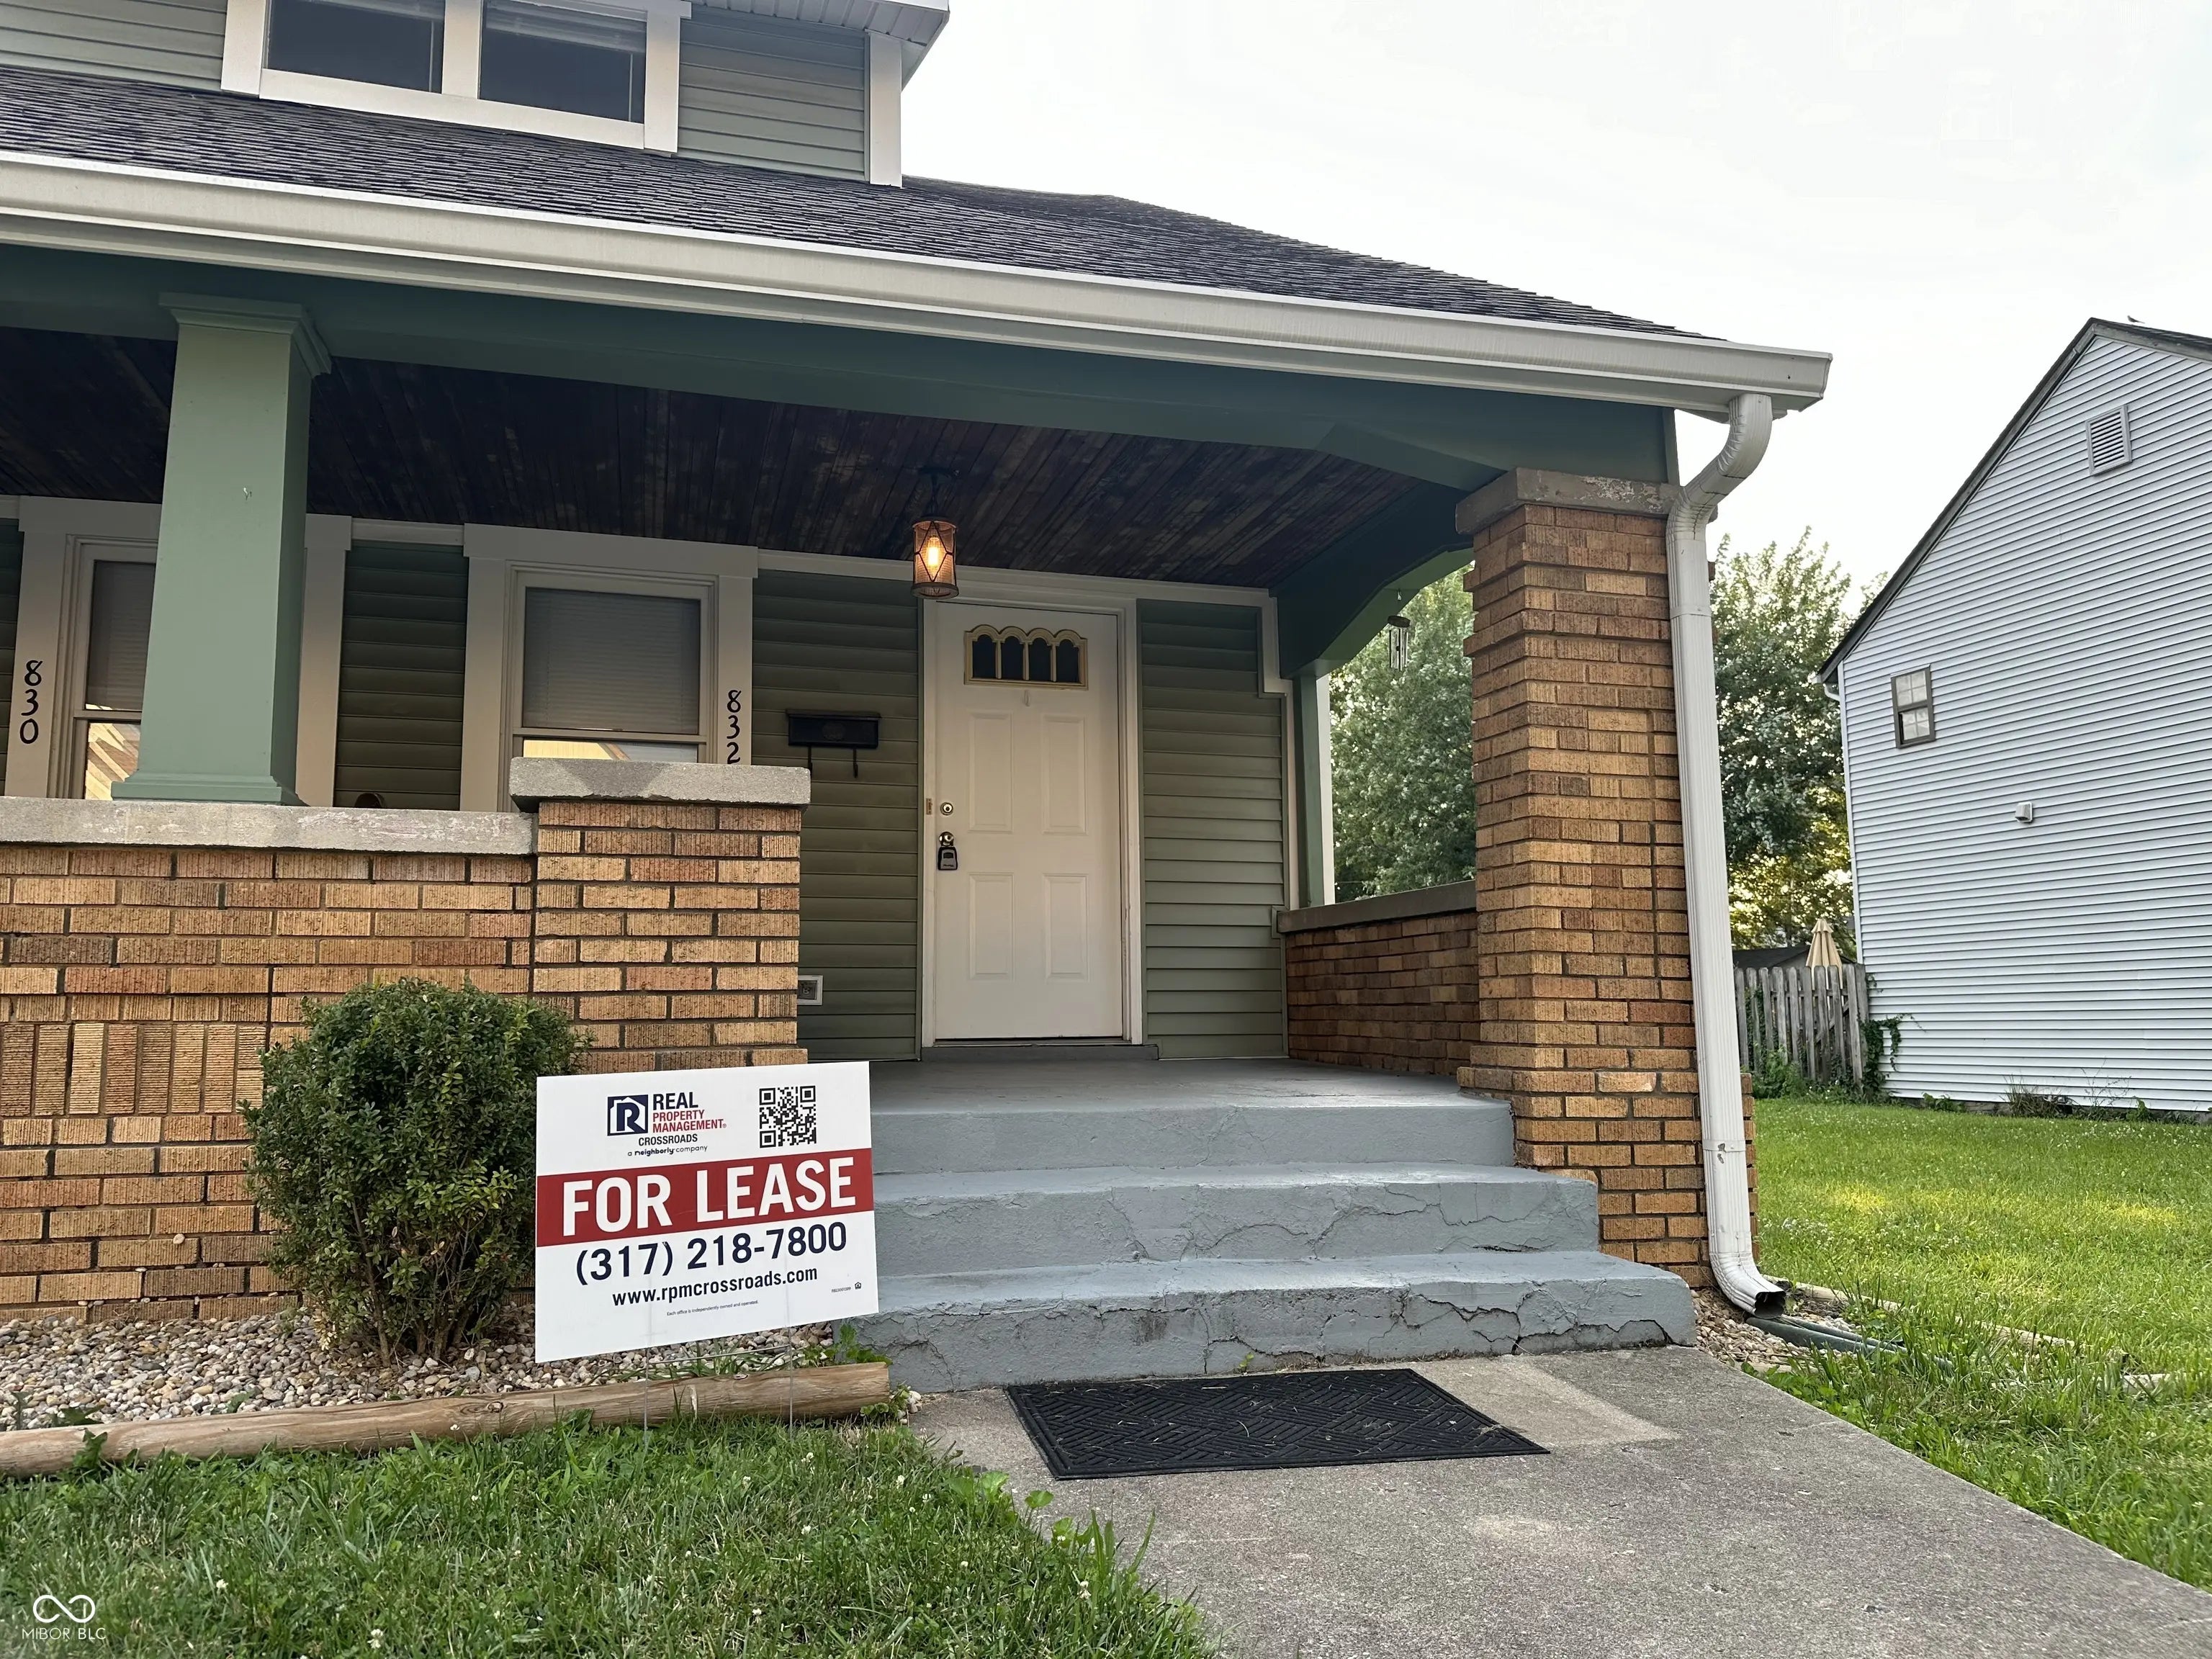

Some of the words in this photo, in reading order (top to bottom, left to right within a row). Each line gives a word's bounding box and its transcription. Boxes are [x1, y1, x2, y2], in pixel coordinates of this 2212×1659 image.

[19, 660, 43, 744] 830
[726, 689, 742, 765] 832
[652, 1092, 698, 1110] REAL
[652, 1110, 705, 1122] PROPERTY
[634, 1147, 675, 1156] neighborly
[675, 1146, 708, 1154] company
[638, 1133, 698, 1146] CROSSROADS
[562, 1174, 673, 1237] FOR
[696, 1156, 856, 1223] LEASE
[576, 1241, 673, 1285] (317)
[687, 1222, 847, 1270] 218-7800
[612, 1267, 818, 1306] www.rpmcrossroads.com
